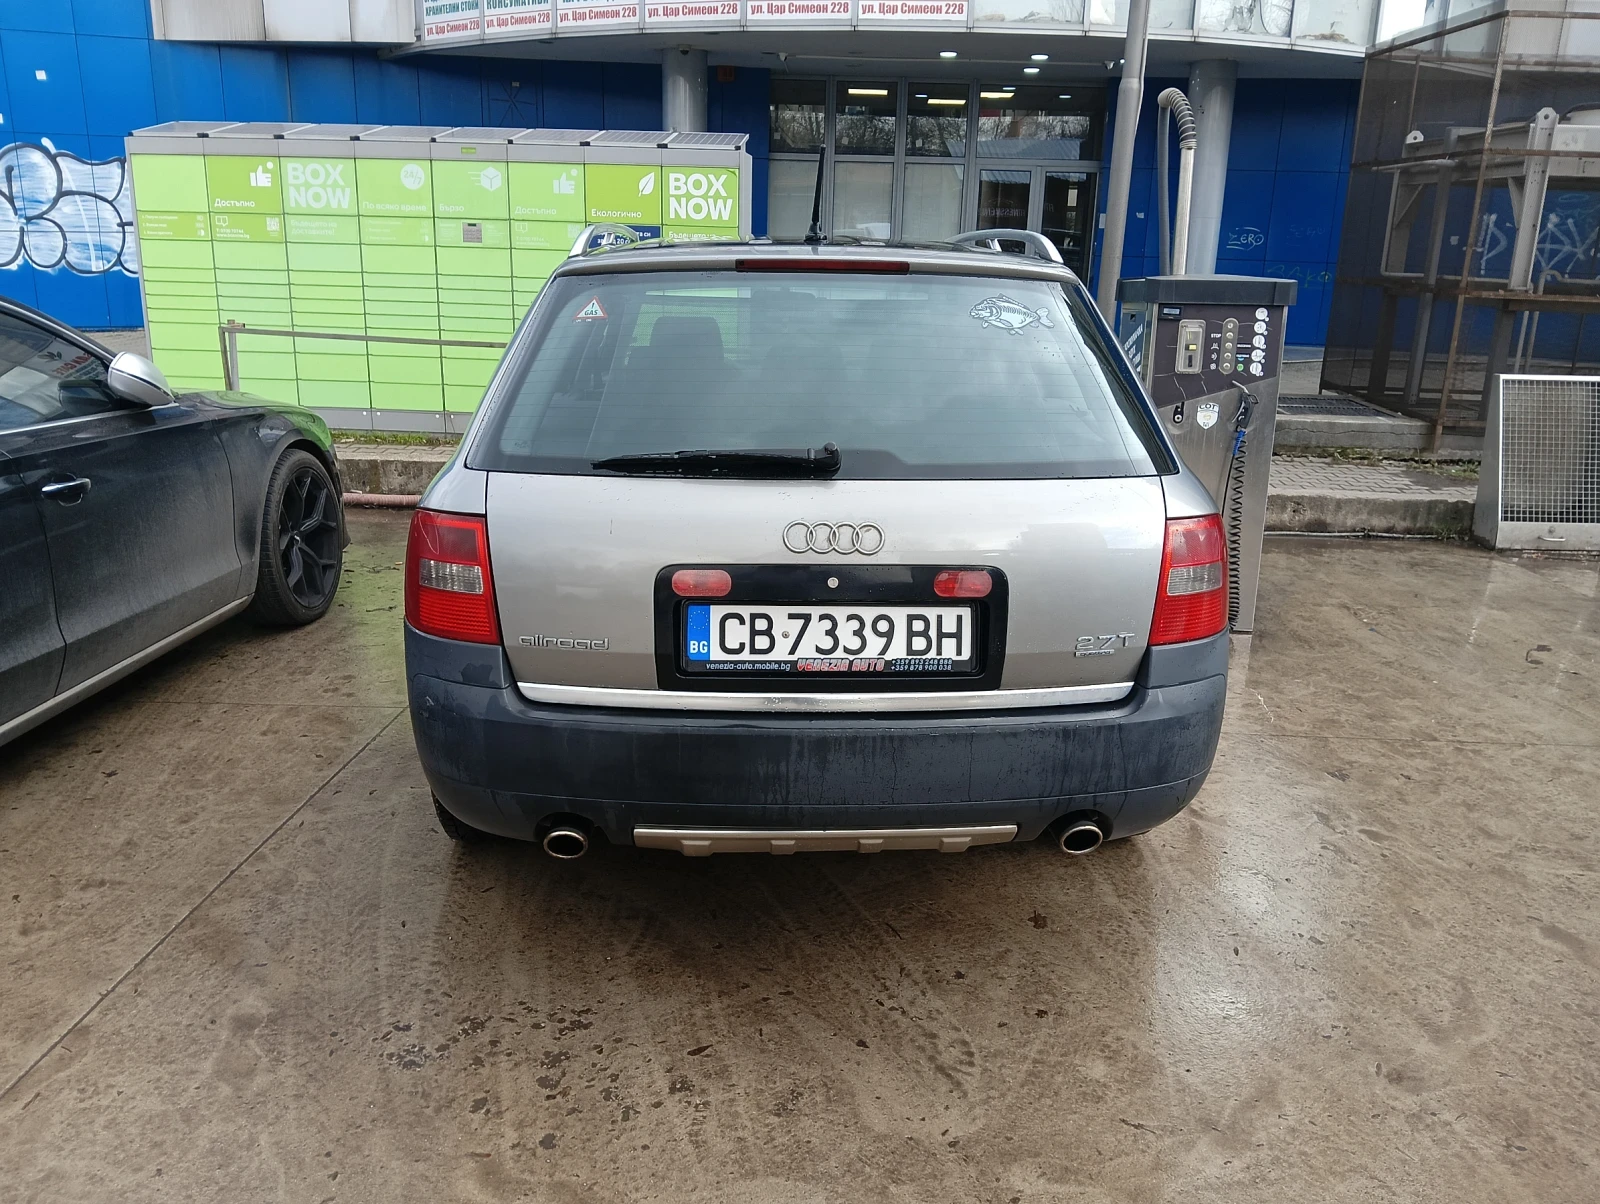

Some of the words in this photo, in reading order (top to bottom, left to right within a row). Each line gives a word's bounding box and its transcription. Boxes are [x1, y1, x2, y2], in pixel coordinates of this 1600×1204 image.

[559, 12, 571, 22] ул.
[571, 10, 587, 22] Цар
[588, 9, 620, 20] Симеон
[622, 6, 637, 18] 228
[648, 8, 661, 18] ул.
[663, 6, 680, 18] Цар
[682, 5, 718, 16] Симеон
[721, 3, 738, 14] 228
[750, 4, 765, 15] ул.
[767, 3, 786, 15] Цар
[788, 2, 828, 14] Симеон
[830, 2, 849, 14] 228
[861, 4, 876, 15] ул.
[878, 2, 899, 15] Цар
[900, 2, 942, 14] Симеон
[945, 3, 964, 15] 228
[426, 27, 435, 36] ул.
[435, 25, 446, 36] Цар
[446, 22, 469, 33] Симеон
[469, 19, 480, 31] 228
[486, 19, 495, 29] ул.
[496, 17, 509, 28] Цар
[510, 15, 537, 26] Симеон
[537, 12, 551, 23] 228
[286, 163, 345, 186] BOX
[403, 168, 422, 185] 24/7
[668, 173, 728, 197] BOX
[214, 198, 256, 208] Достъпно
[288, 186, 350, 209] NOW
[362, 201, 375, 209] По
[401, 204, 427, 212] време
[439, 203, 465, 213] Бързо
[514, 205, 557, 216] Достъпно
[591, 208, 642, 218] Екологично
[669, 197, 733, 221] NOW
[519, 634, 609, 650] allroad
[718, 612, 776, 655] CB
[787, 612, 895, 656] 7339
[906, 613, 963, 657] BH
[690, 640, 708, 653] BG
[706, 662, 791, 672] venezia-auto.mobile.bg
[852, 659, 885, 671] AUTO
